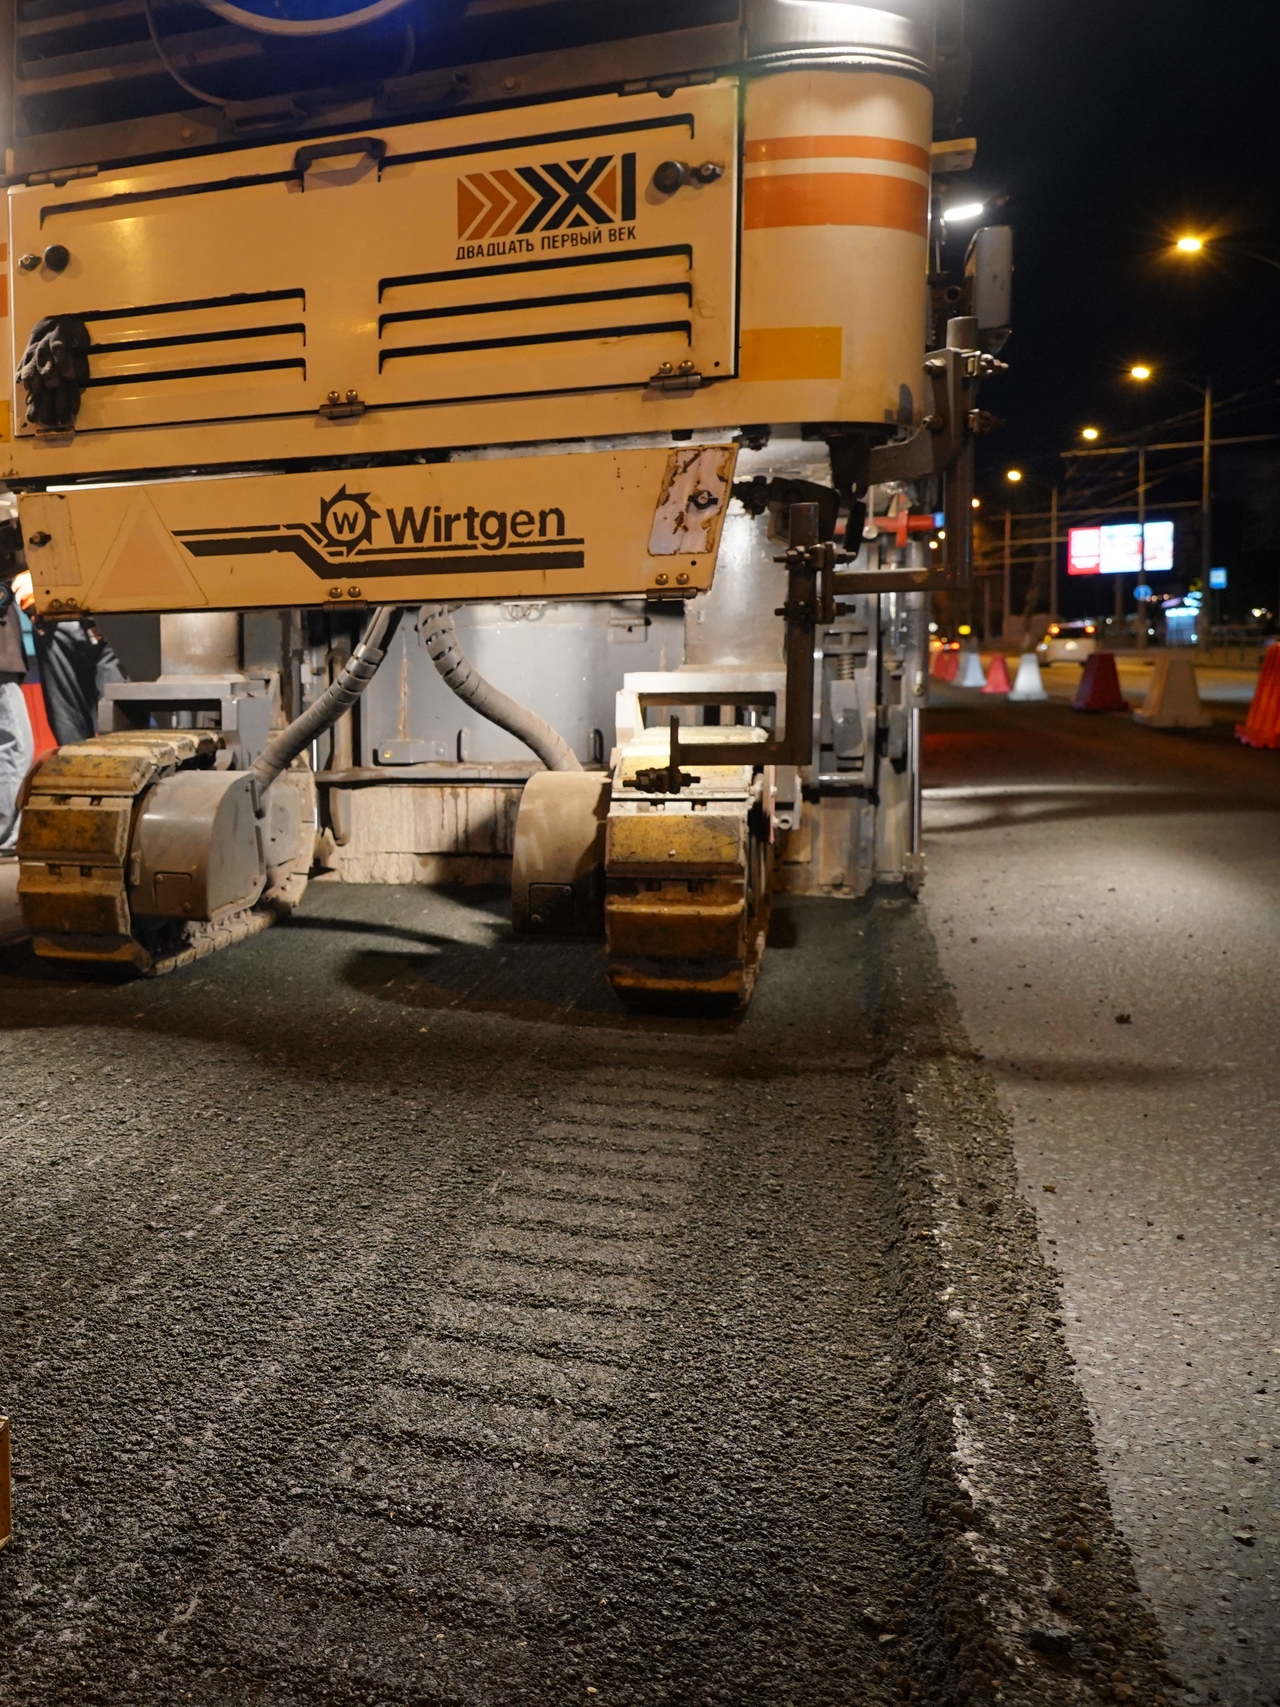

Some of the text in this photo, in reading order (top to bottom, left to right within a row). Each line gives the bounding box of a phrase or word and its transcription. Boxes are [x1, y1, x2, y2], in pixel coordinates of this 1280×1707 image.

[456, 225, 637, 261] ДВАДЦАТЬ ПЕРВЫЙ ВЕК
[385, 505, 566, 551] Wirtgen
